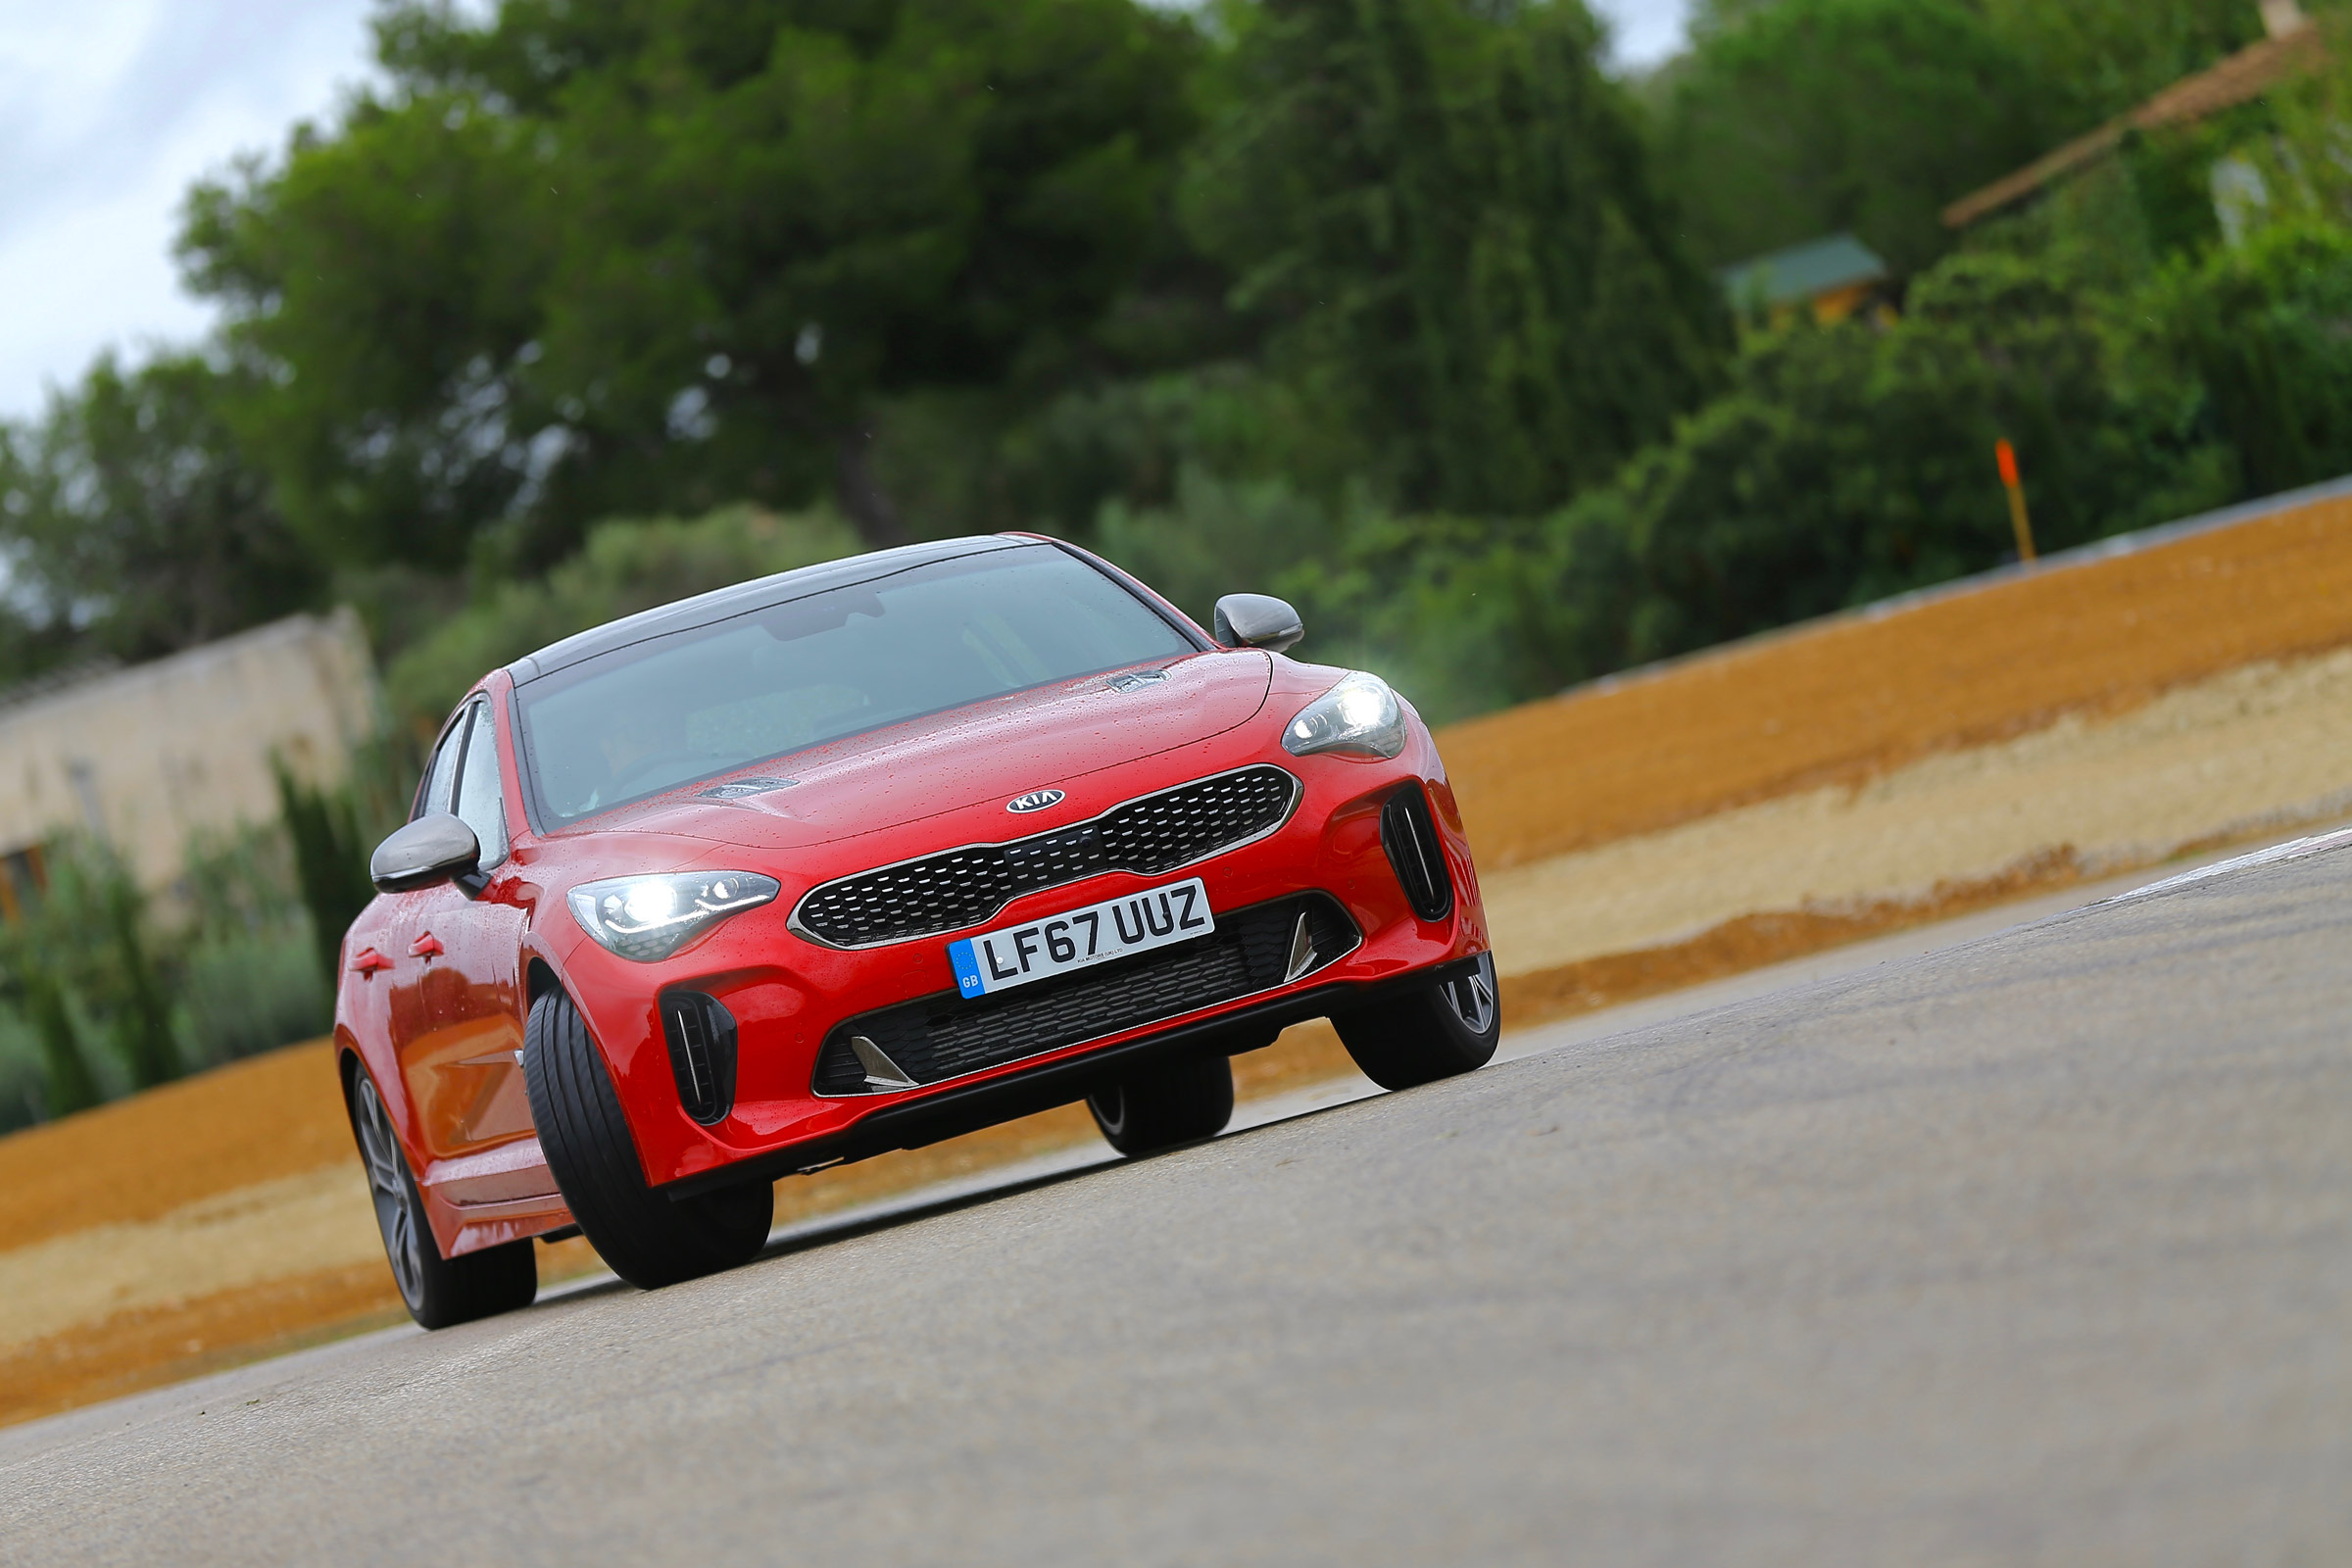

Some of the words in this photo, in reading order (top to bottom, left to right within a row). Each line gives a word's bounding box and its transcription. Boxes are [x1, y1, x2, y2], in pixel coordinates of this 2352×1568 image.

[1014, 791, 1057, 810] KIA
[983, 911, 1100, 981] LF67
[1111, 884, 1205, 945] UUZ
[962, 974, 979, 989] GB
